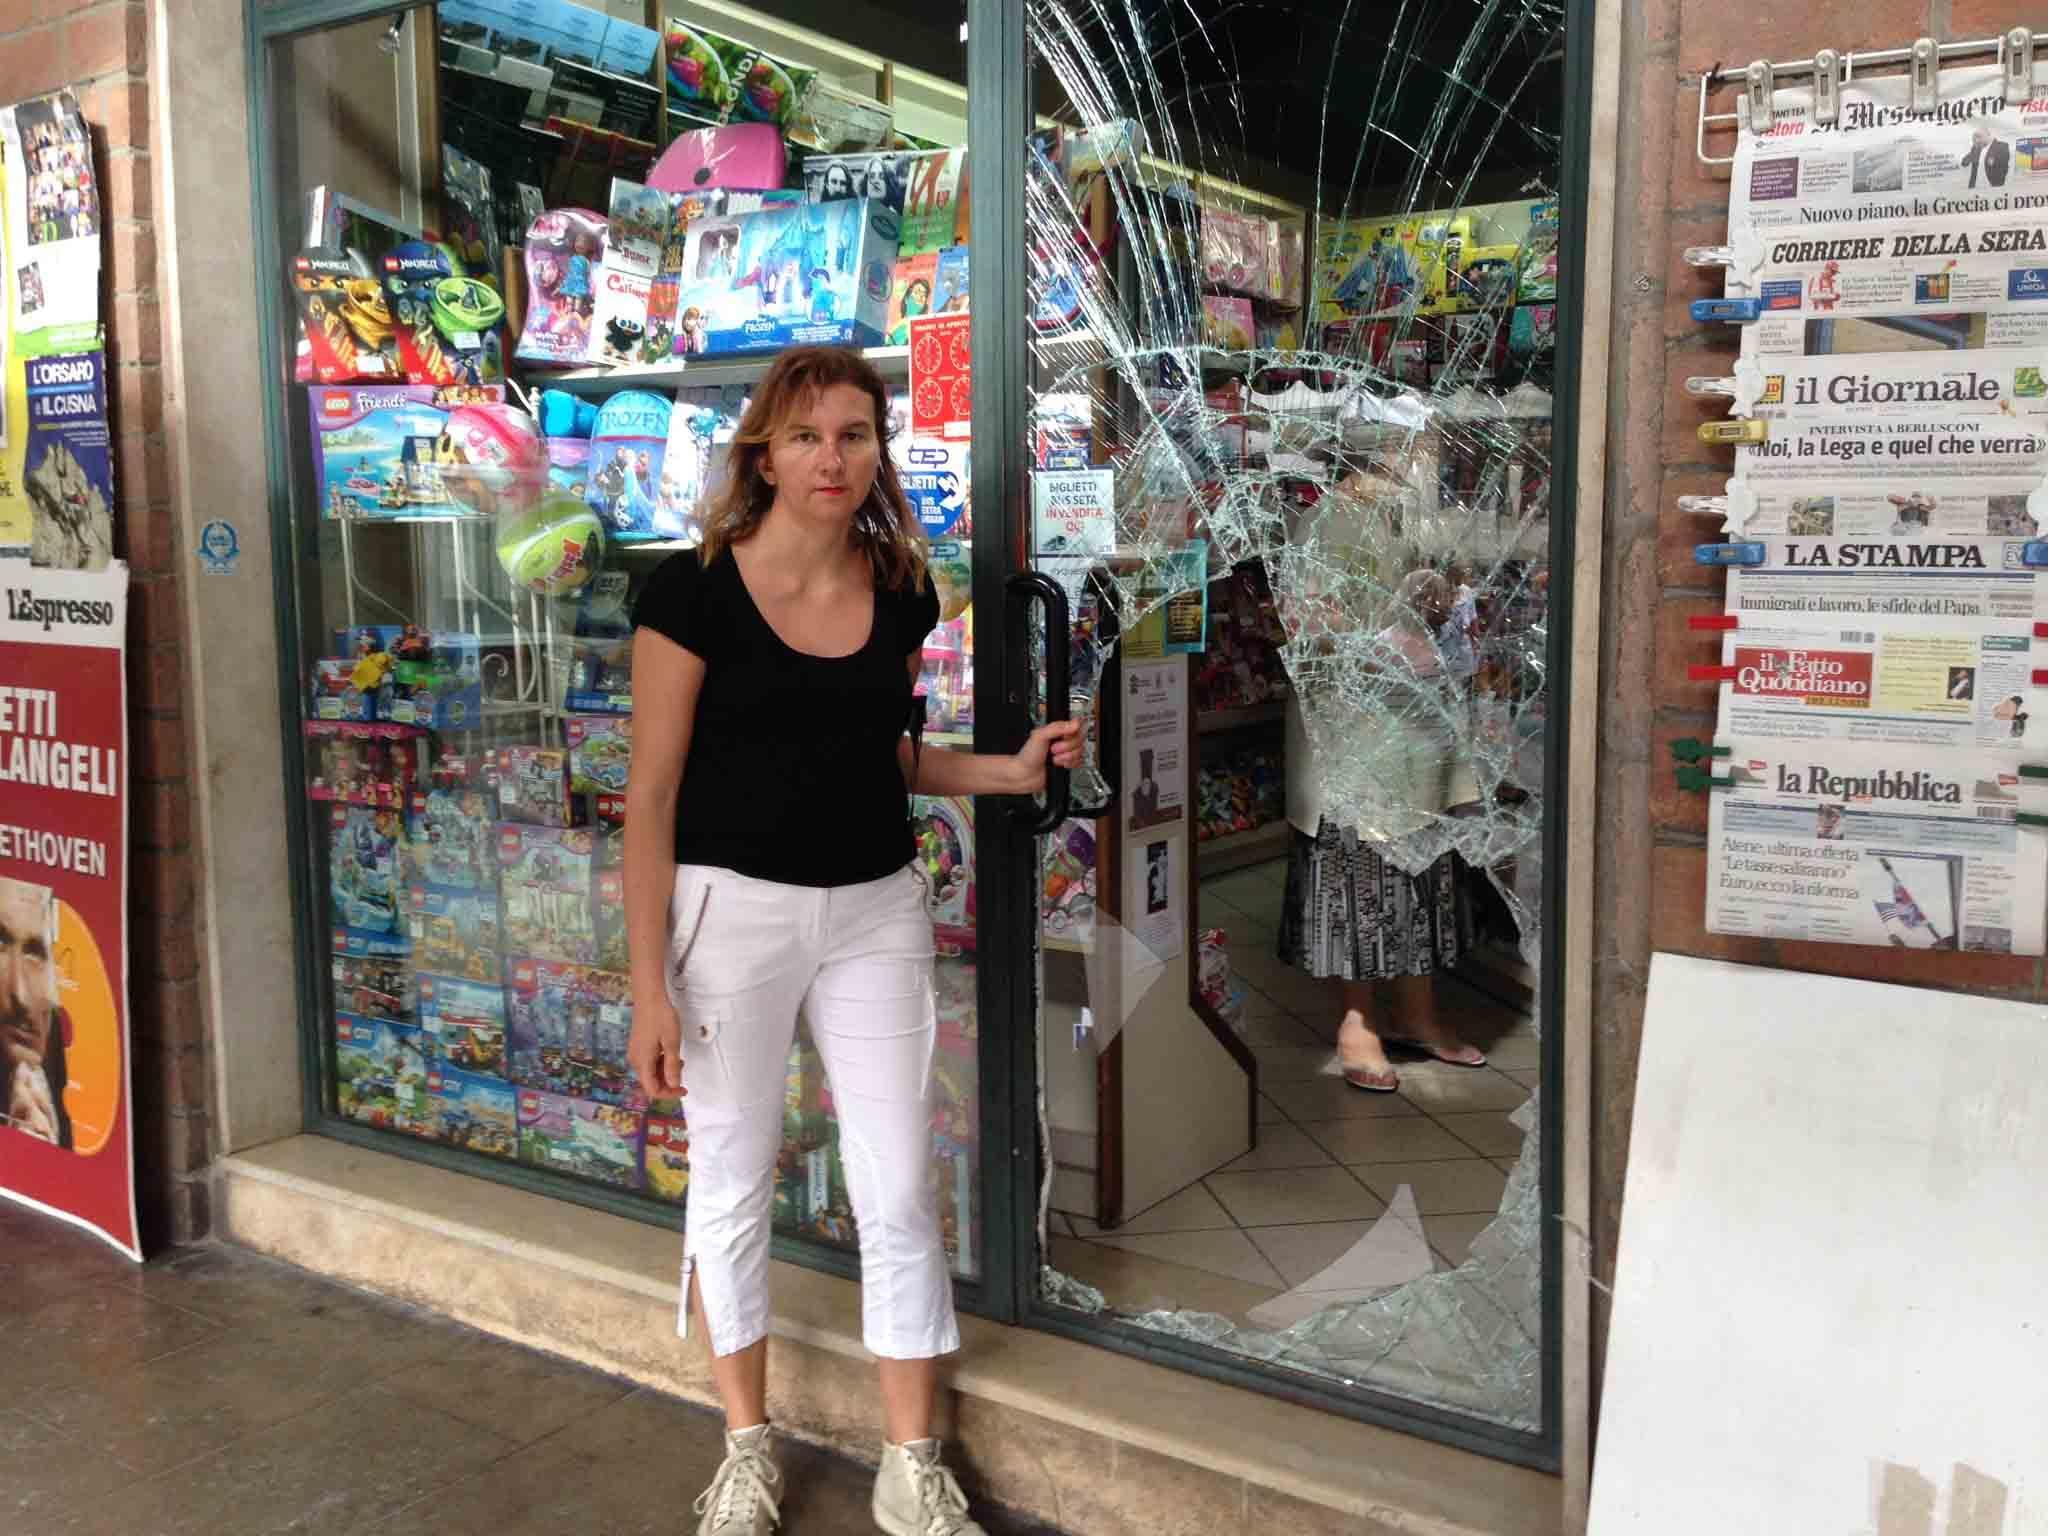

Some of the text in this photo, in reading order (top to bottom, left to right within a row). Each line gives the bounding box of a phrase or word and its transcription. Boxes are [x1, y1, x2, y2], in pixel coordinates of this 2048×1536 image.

[1800, 206, 1853, 224] Nuovo
[1913, 197, 1930, 217] la
[1933, 194, 1989, 215] Grecia
[1994, 192, 2009, 211] ci
[1772, 229, 2046, 264] CORRIERE DELLA SERA
[32, 360, 94, 384] L'ORSARO
[1795, 372, 2001, 406] il Giornale
[1809, 422, 1980, 436] INTERVISTA A BERLUSCONI
[1798, 438, 1814, 456] la
[1820, 438, 1866, 460] Lega
[1872, 441, 1883, 455] e
[1889, 435, 1933, 459] quel
[1938, 434, 1974, 455] che
[1980, 433, 2047, 454] verrà»
[1073, 495, 1098, 506] SETA
[1784, 543, 1986, 568] LA STAMPA
[6, 588, 113, 631] l'Espresso
[1740, 596, 1806, 612] Immigrati
[1807, 600, 1815, 610] e
[1867, 599, 1879, 612] le
[1882, 599, 1917, 613] sfide
[1919, 599, 1941, 613] del
[1944, 600, 1980, 616] Papa
[1760, 650, 1843, 674] il Fatto
[1738, 666, 1866, 694] Quotidiano
[1778, 764, 1961, 803] la Repubblica
[0, 824, 106, 877] ETHOVEN
